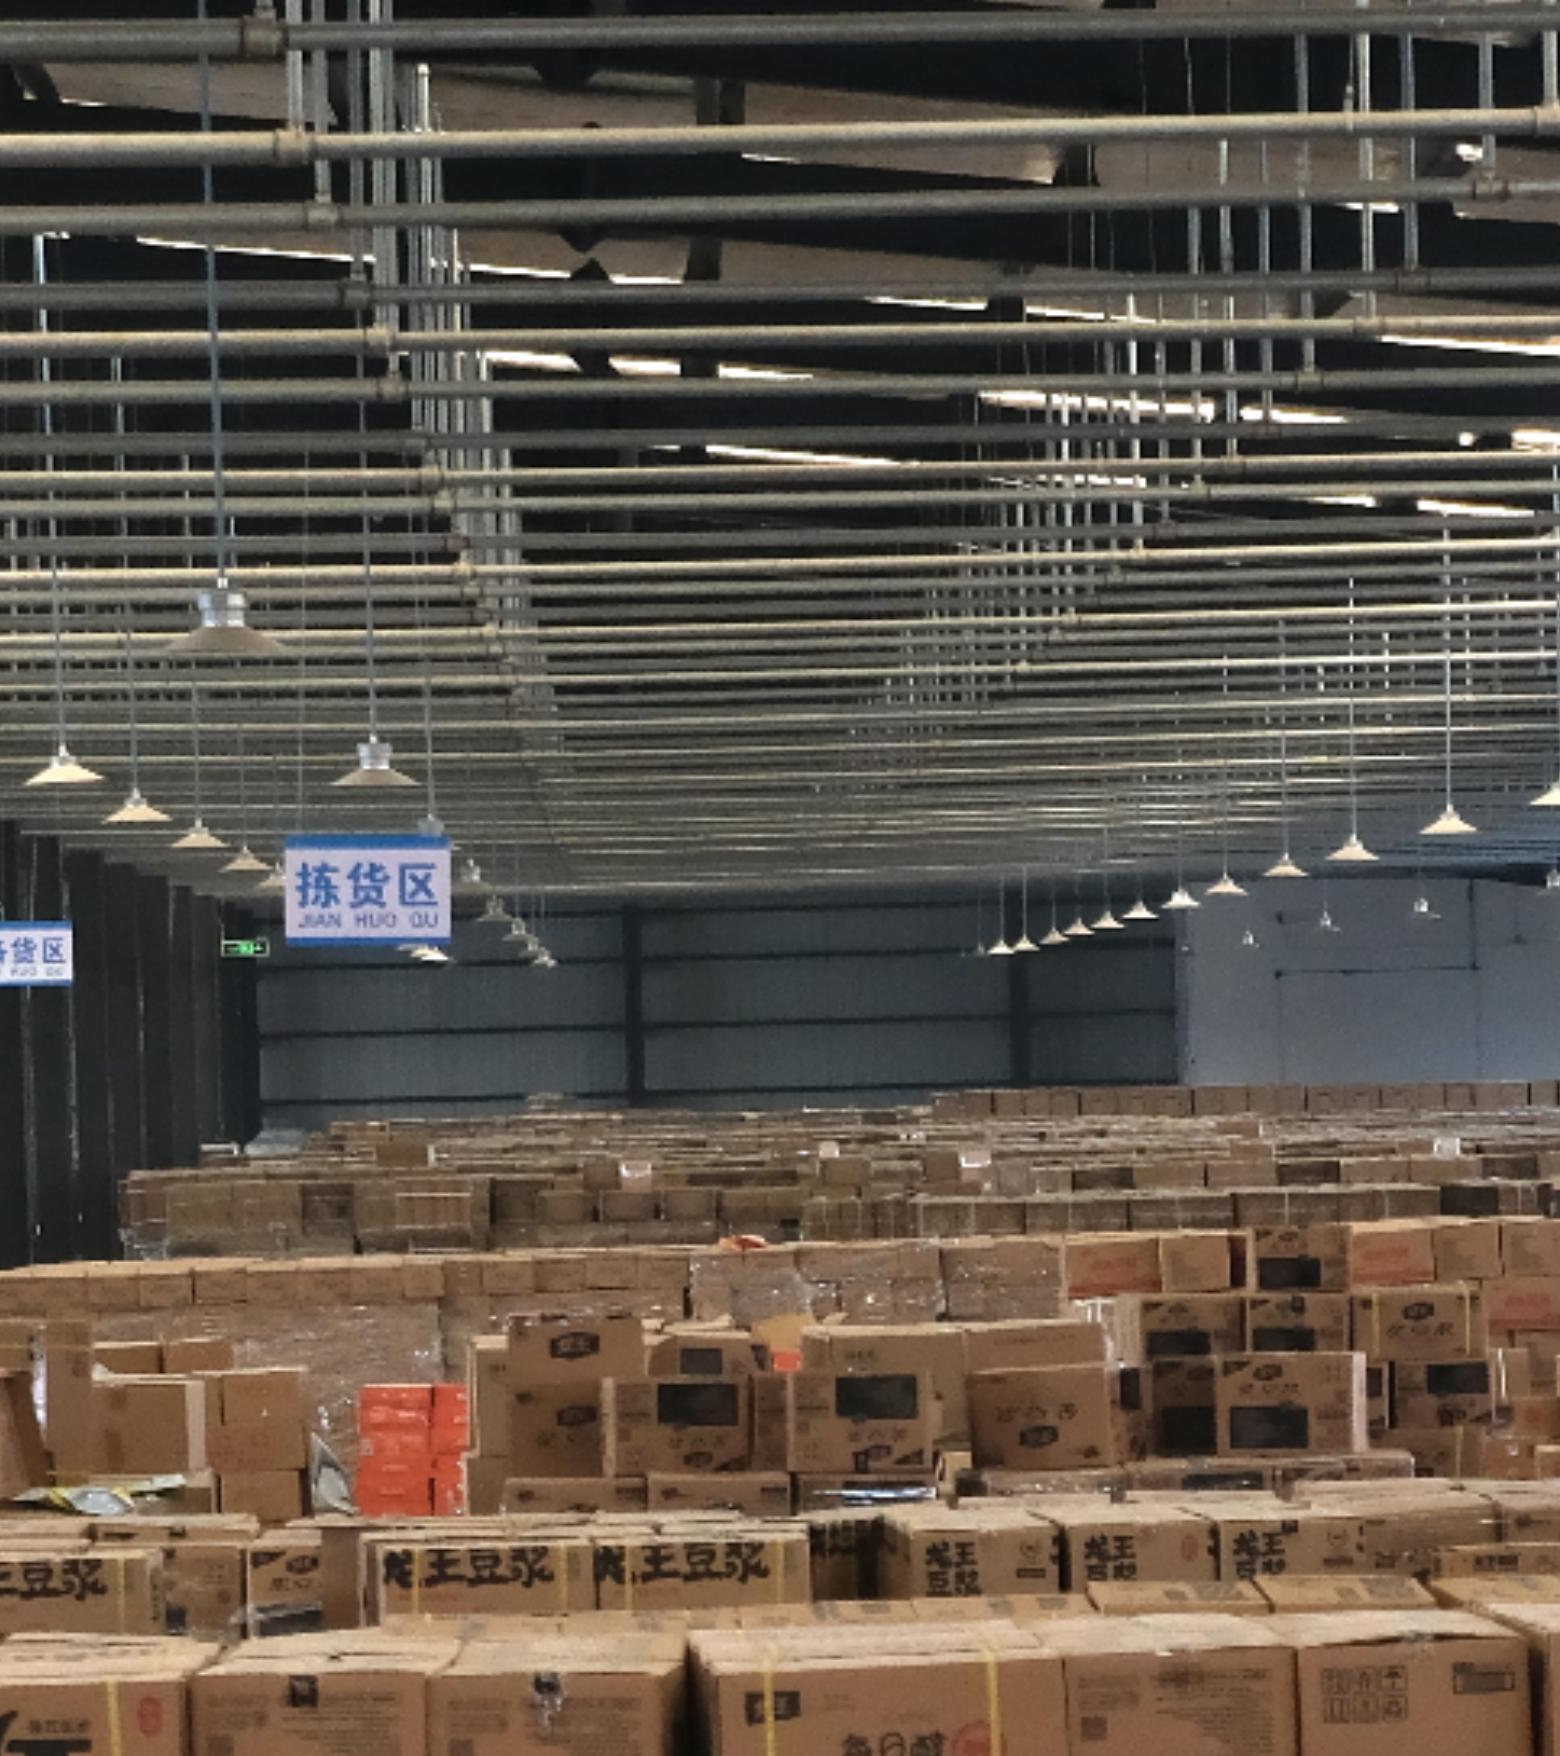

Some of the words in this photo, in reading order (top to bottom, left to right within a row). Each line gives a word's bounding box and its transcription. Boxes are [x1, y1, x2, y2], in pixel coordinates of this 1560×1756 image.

[295, 861, 440, 909] 拣货区
[298, 913, 344, 930] JIAN
[355, 913, 398, 929] HUO
[409, 912, 440, 929] QU
[384, 1545, 554, 1588] 龙王豆浆
[596, 1542, 769, 1584] 龙王豆浆
